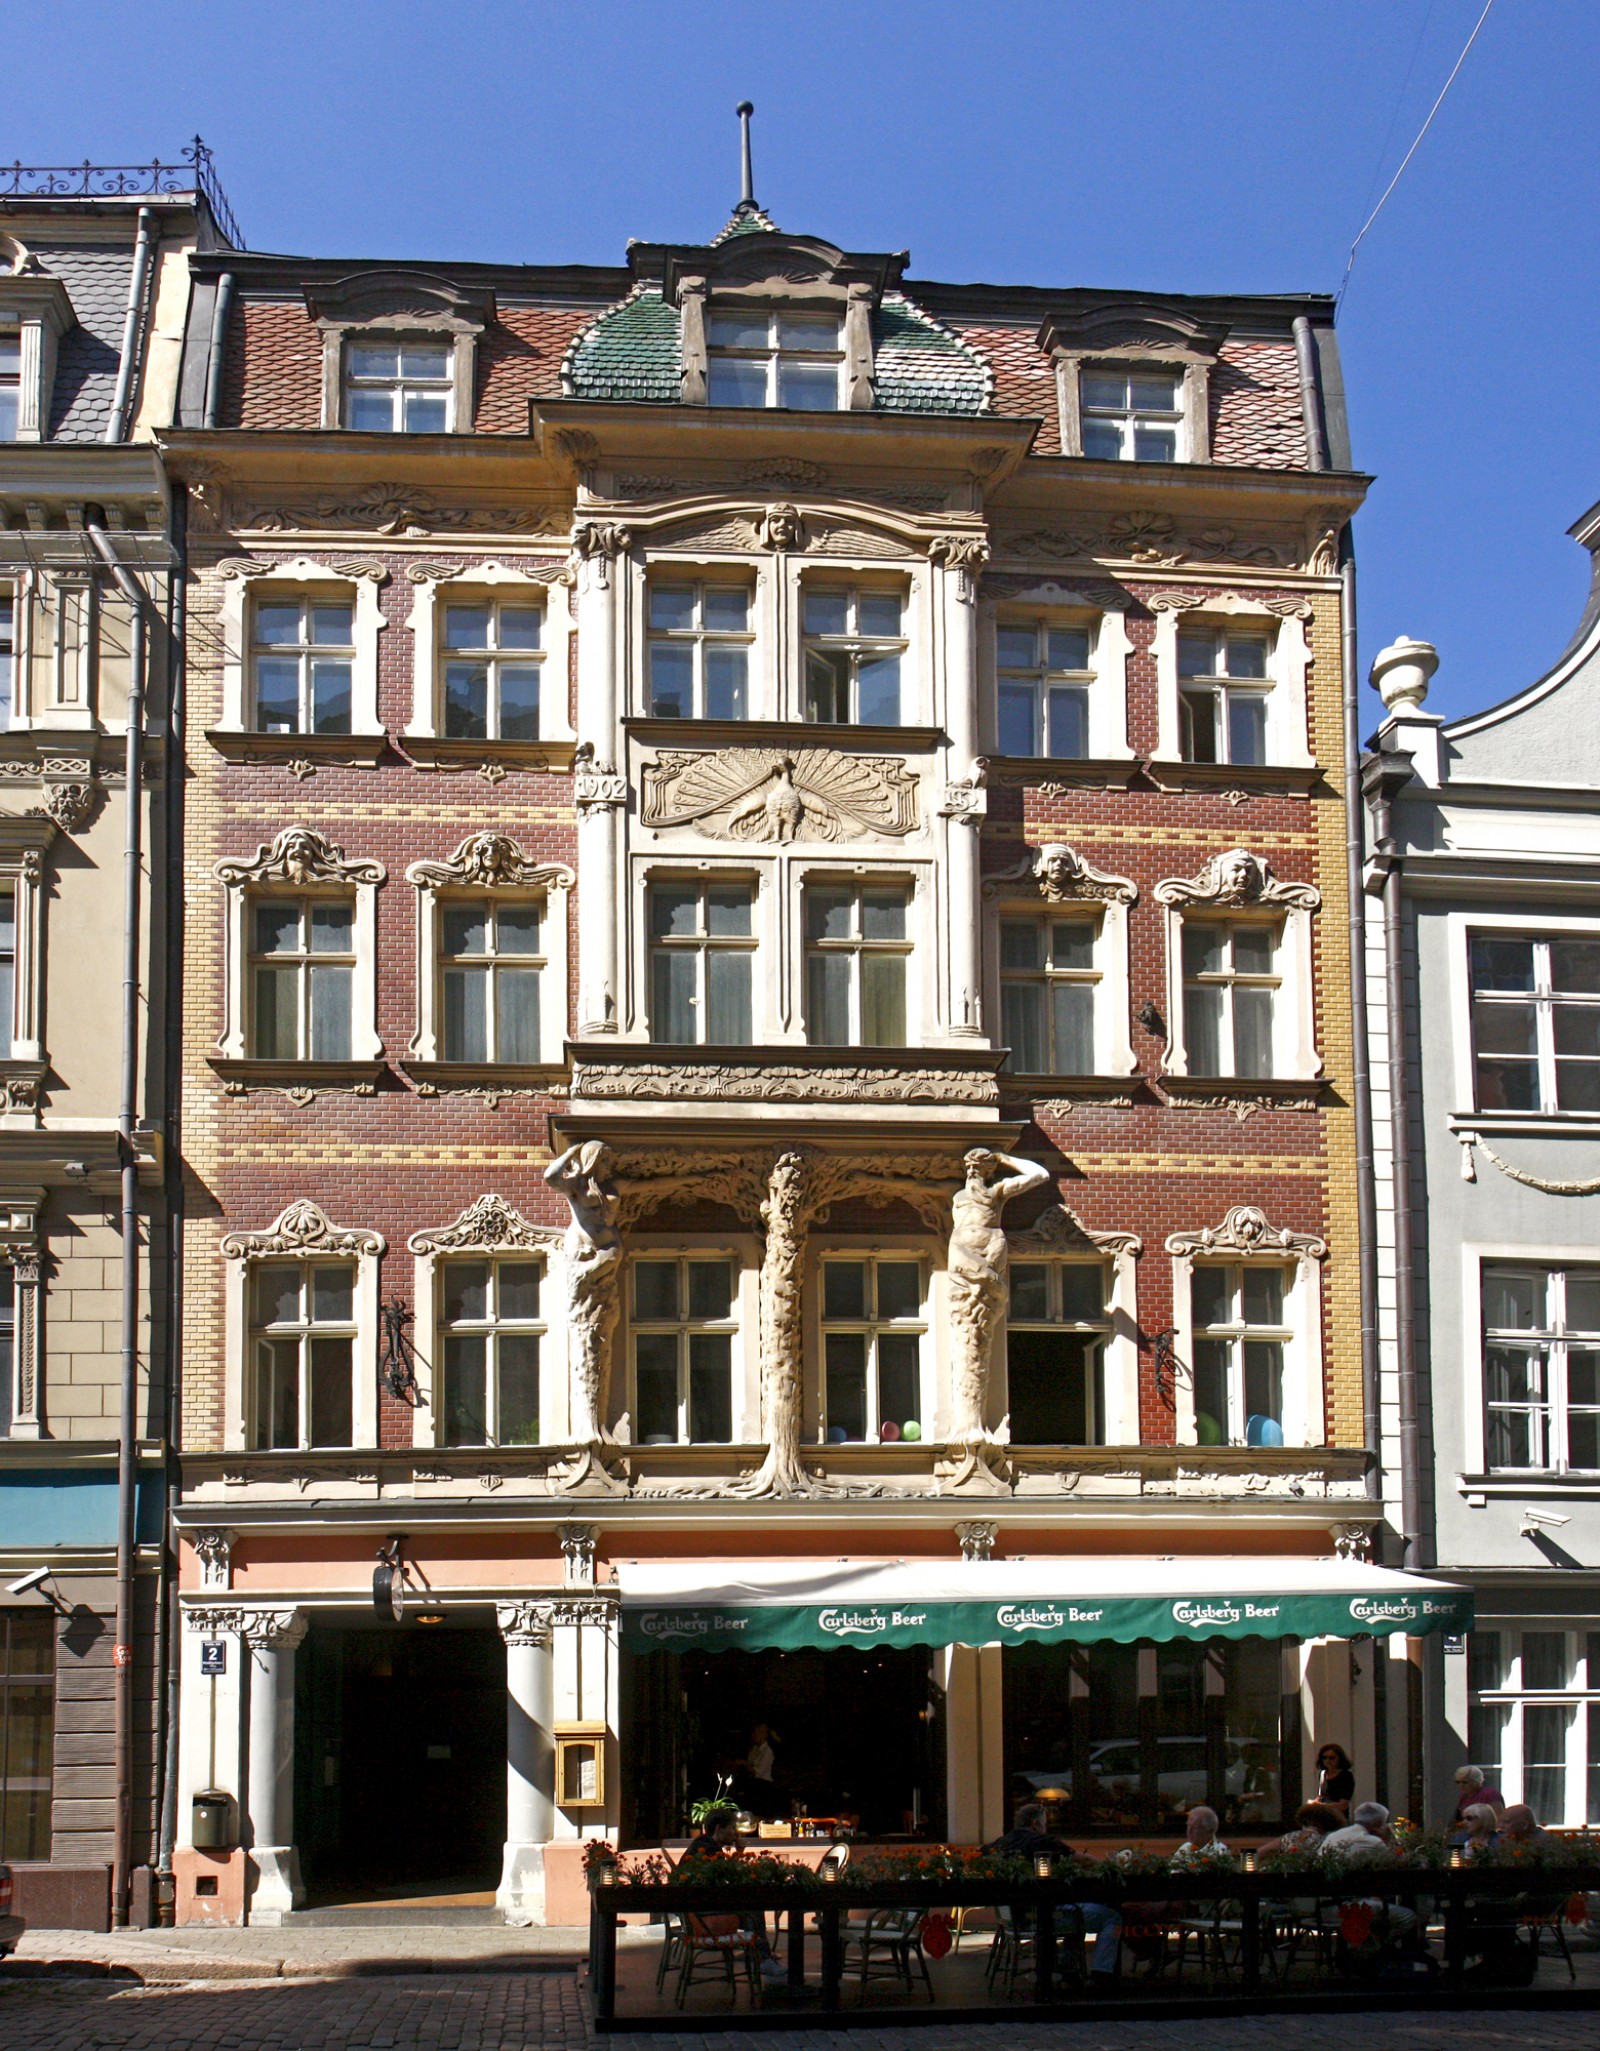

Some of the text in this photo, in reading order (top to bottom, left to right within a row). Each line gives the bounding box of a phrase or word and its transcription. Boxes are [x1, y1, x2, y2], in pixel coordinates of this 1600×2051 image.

[577, 778, 627, 799] 1902
[996, 1606, 1103, 1627] Carlsberg Beer
[1172, 1602, 1280, 1623] Carlsberg Beer
[1350, 1598, 1456, 1619] Carlsberg Beer
[640, 1612, 749, 1635] Carlsberg Beer
[818, 1609, 926, 1631] Carlsberg Beer
[208, 1648, 218, 1661] 2
